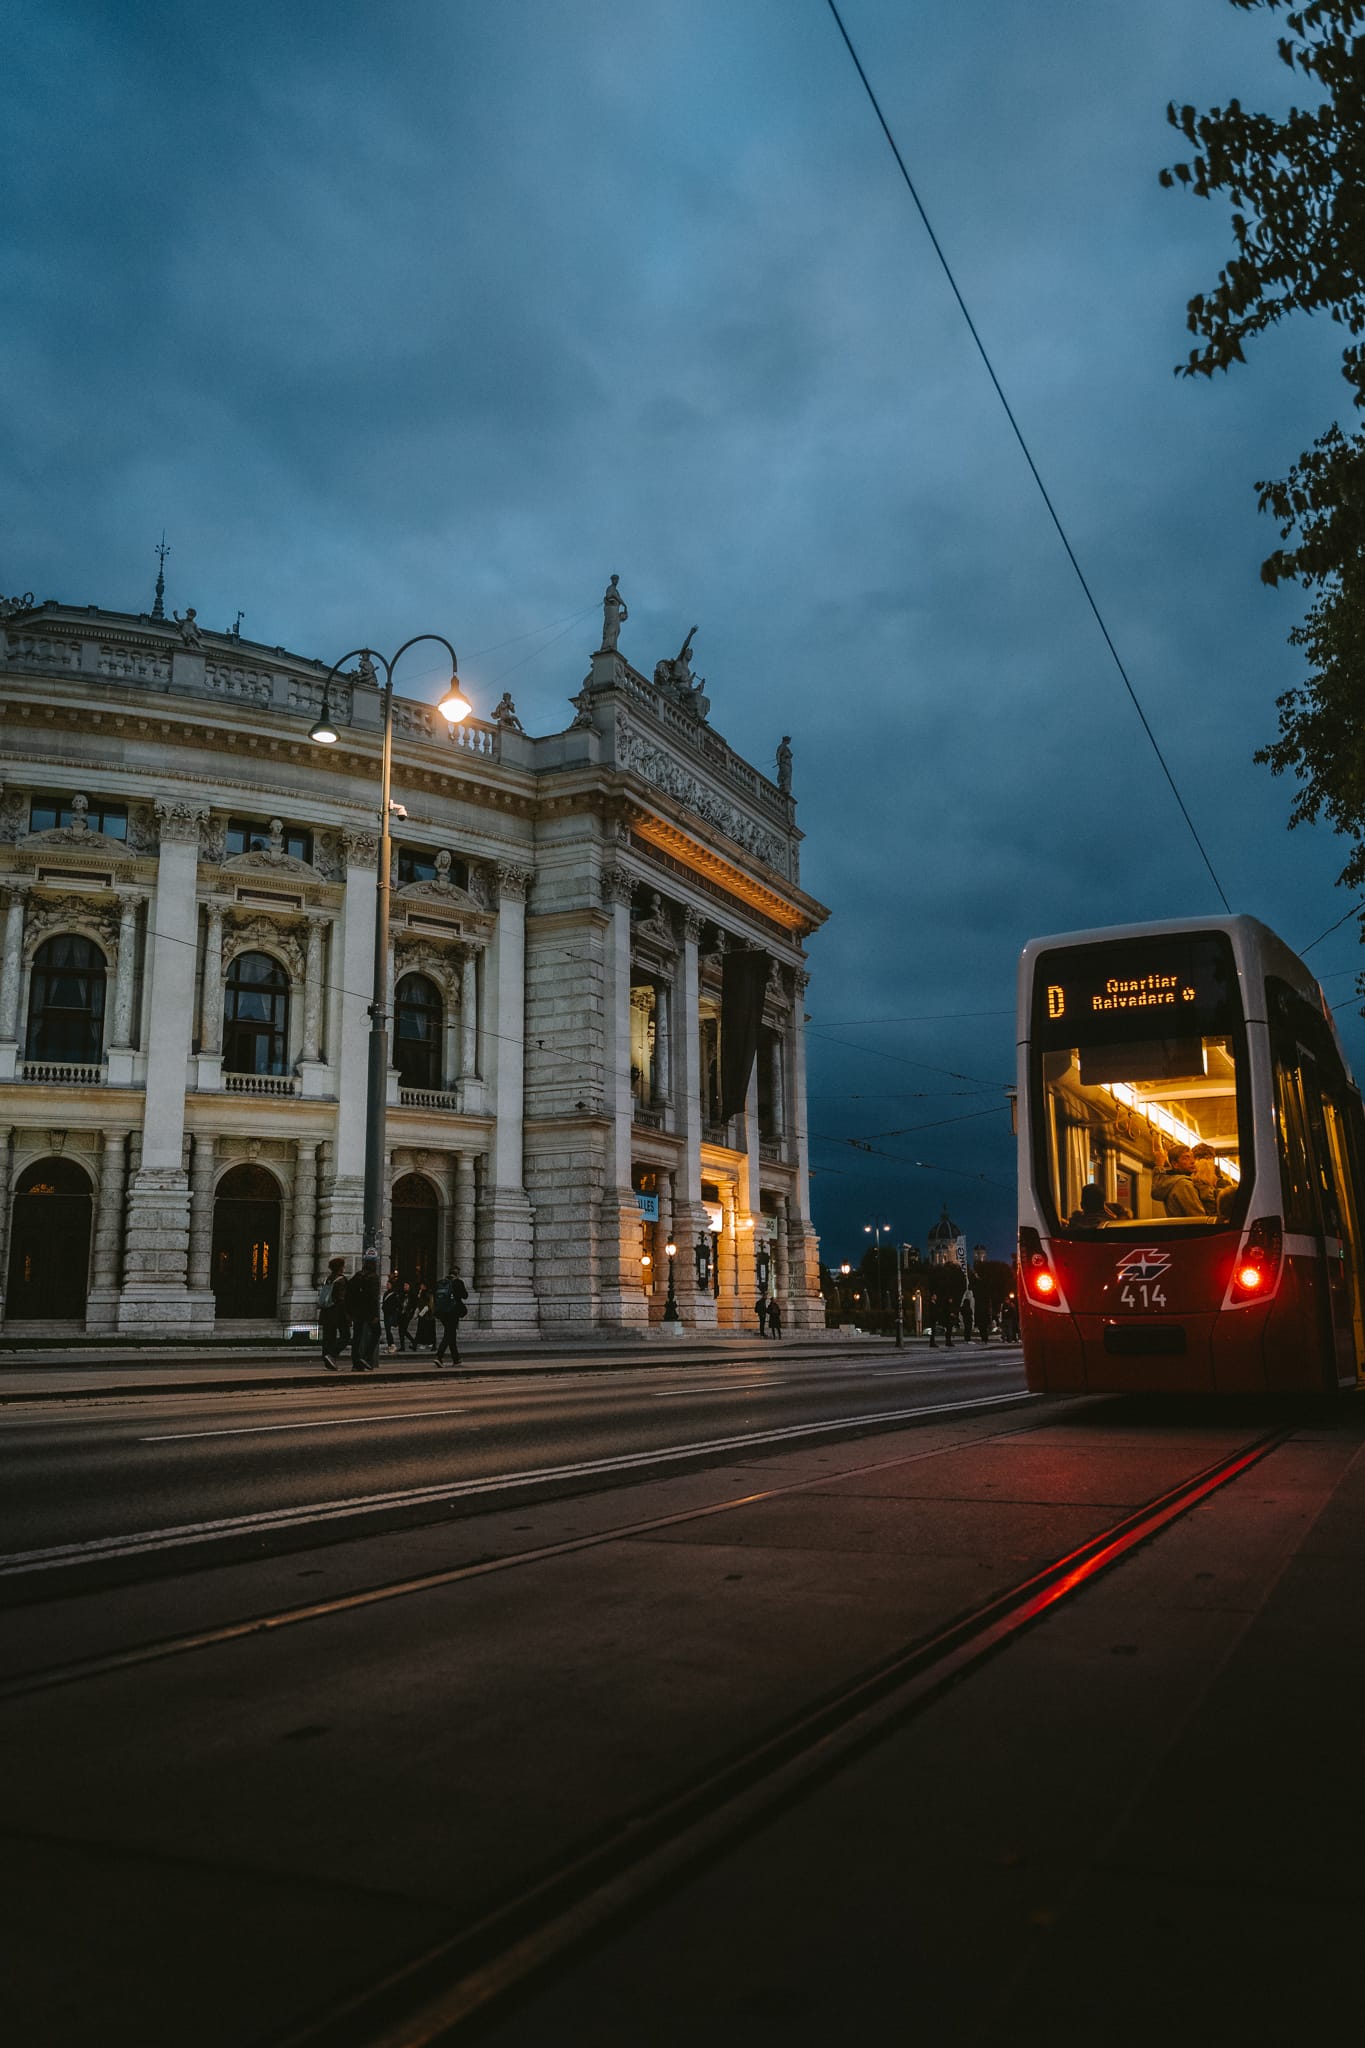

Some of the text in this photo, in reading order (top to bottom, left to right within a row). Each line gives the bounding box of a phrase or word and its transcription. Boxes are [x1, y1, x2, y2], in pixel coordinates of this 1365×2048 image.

[1106, 974, 1177, 993] Quartier
[1047, 986, 1065, 1018] D
[1120, 1284, 1167, 1308] 414
